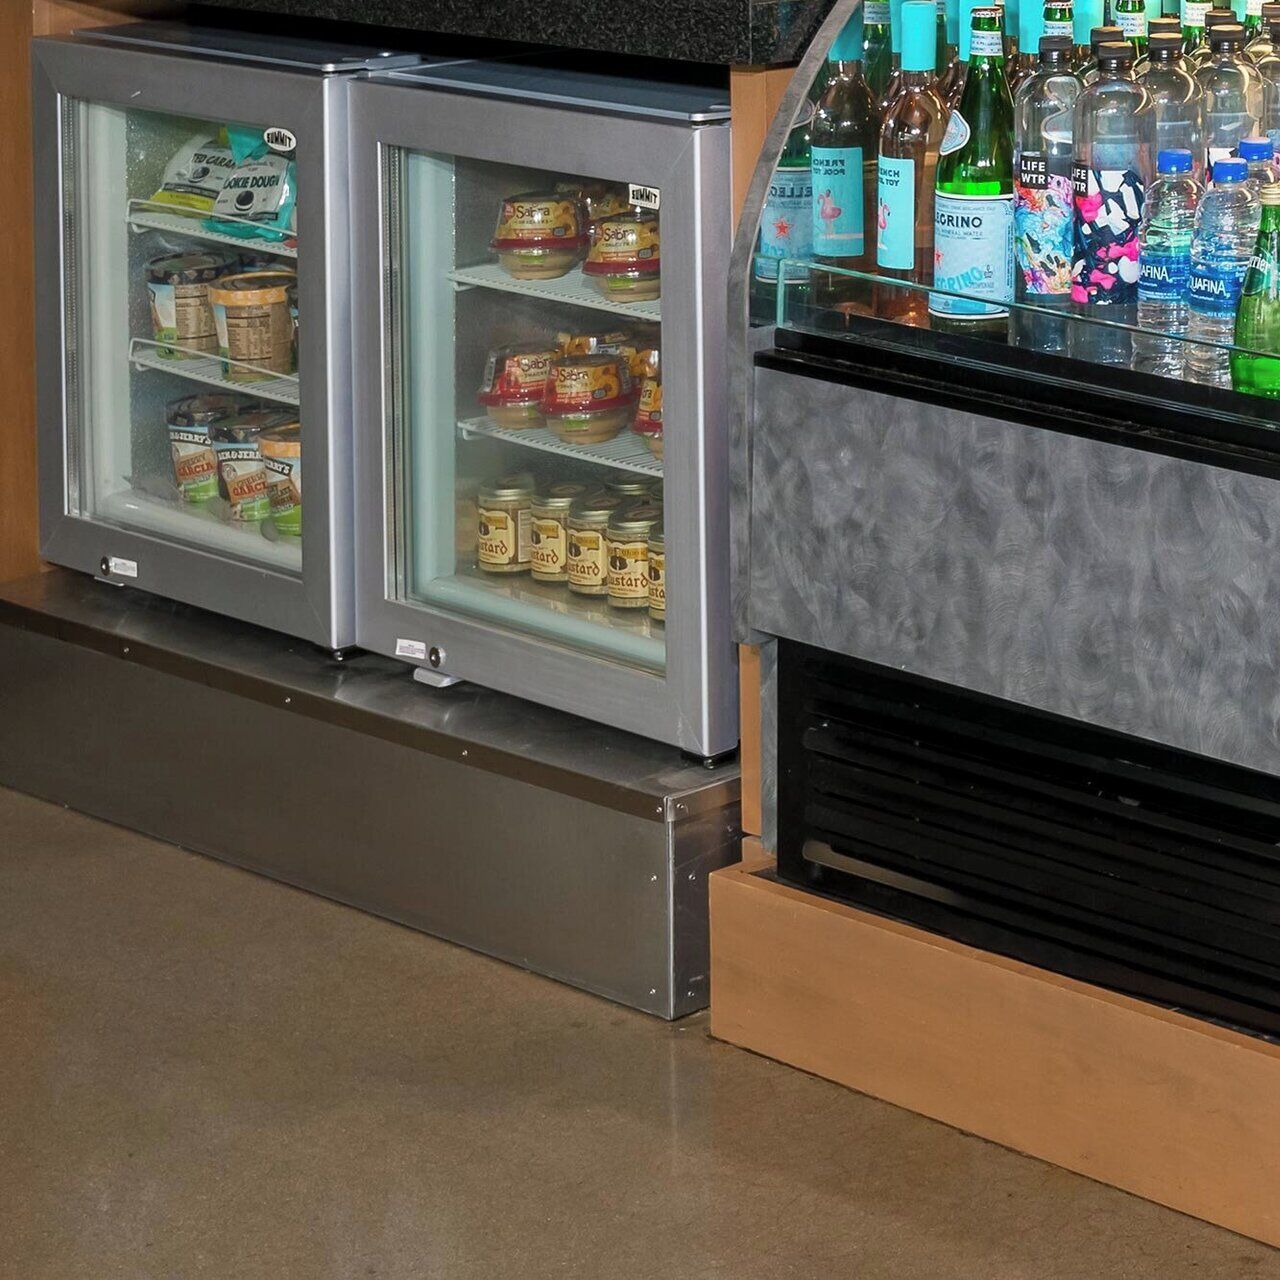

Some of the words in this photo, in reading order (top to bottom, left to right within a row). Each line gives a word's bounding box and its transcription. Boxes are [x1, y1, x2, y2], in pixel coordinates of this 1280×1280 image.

[267, 131, 292, 148] SUMMIT
[1021, 160, 1045, 172] LIFE
[1021, 173, 1045, 185] WTR
[631, 189, 659, 205] SUMMIT
[516, 205, 550, 218] Sabra
[603, 228, 635, 242] Sabra
[559, 369, 588, 382] Sabra
